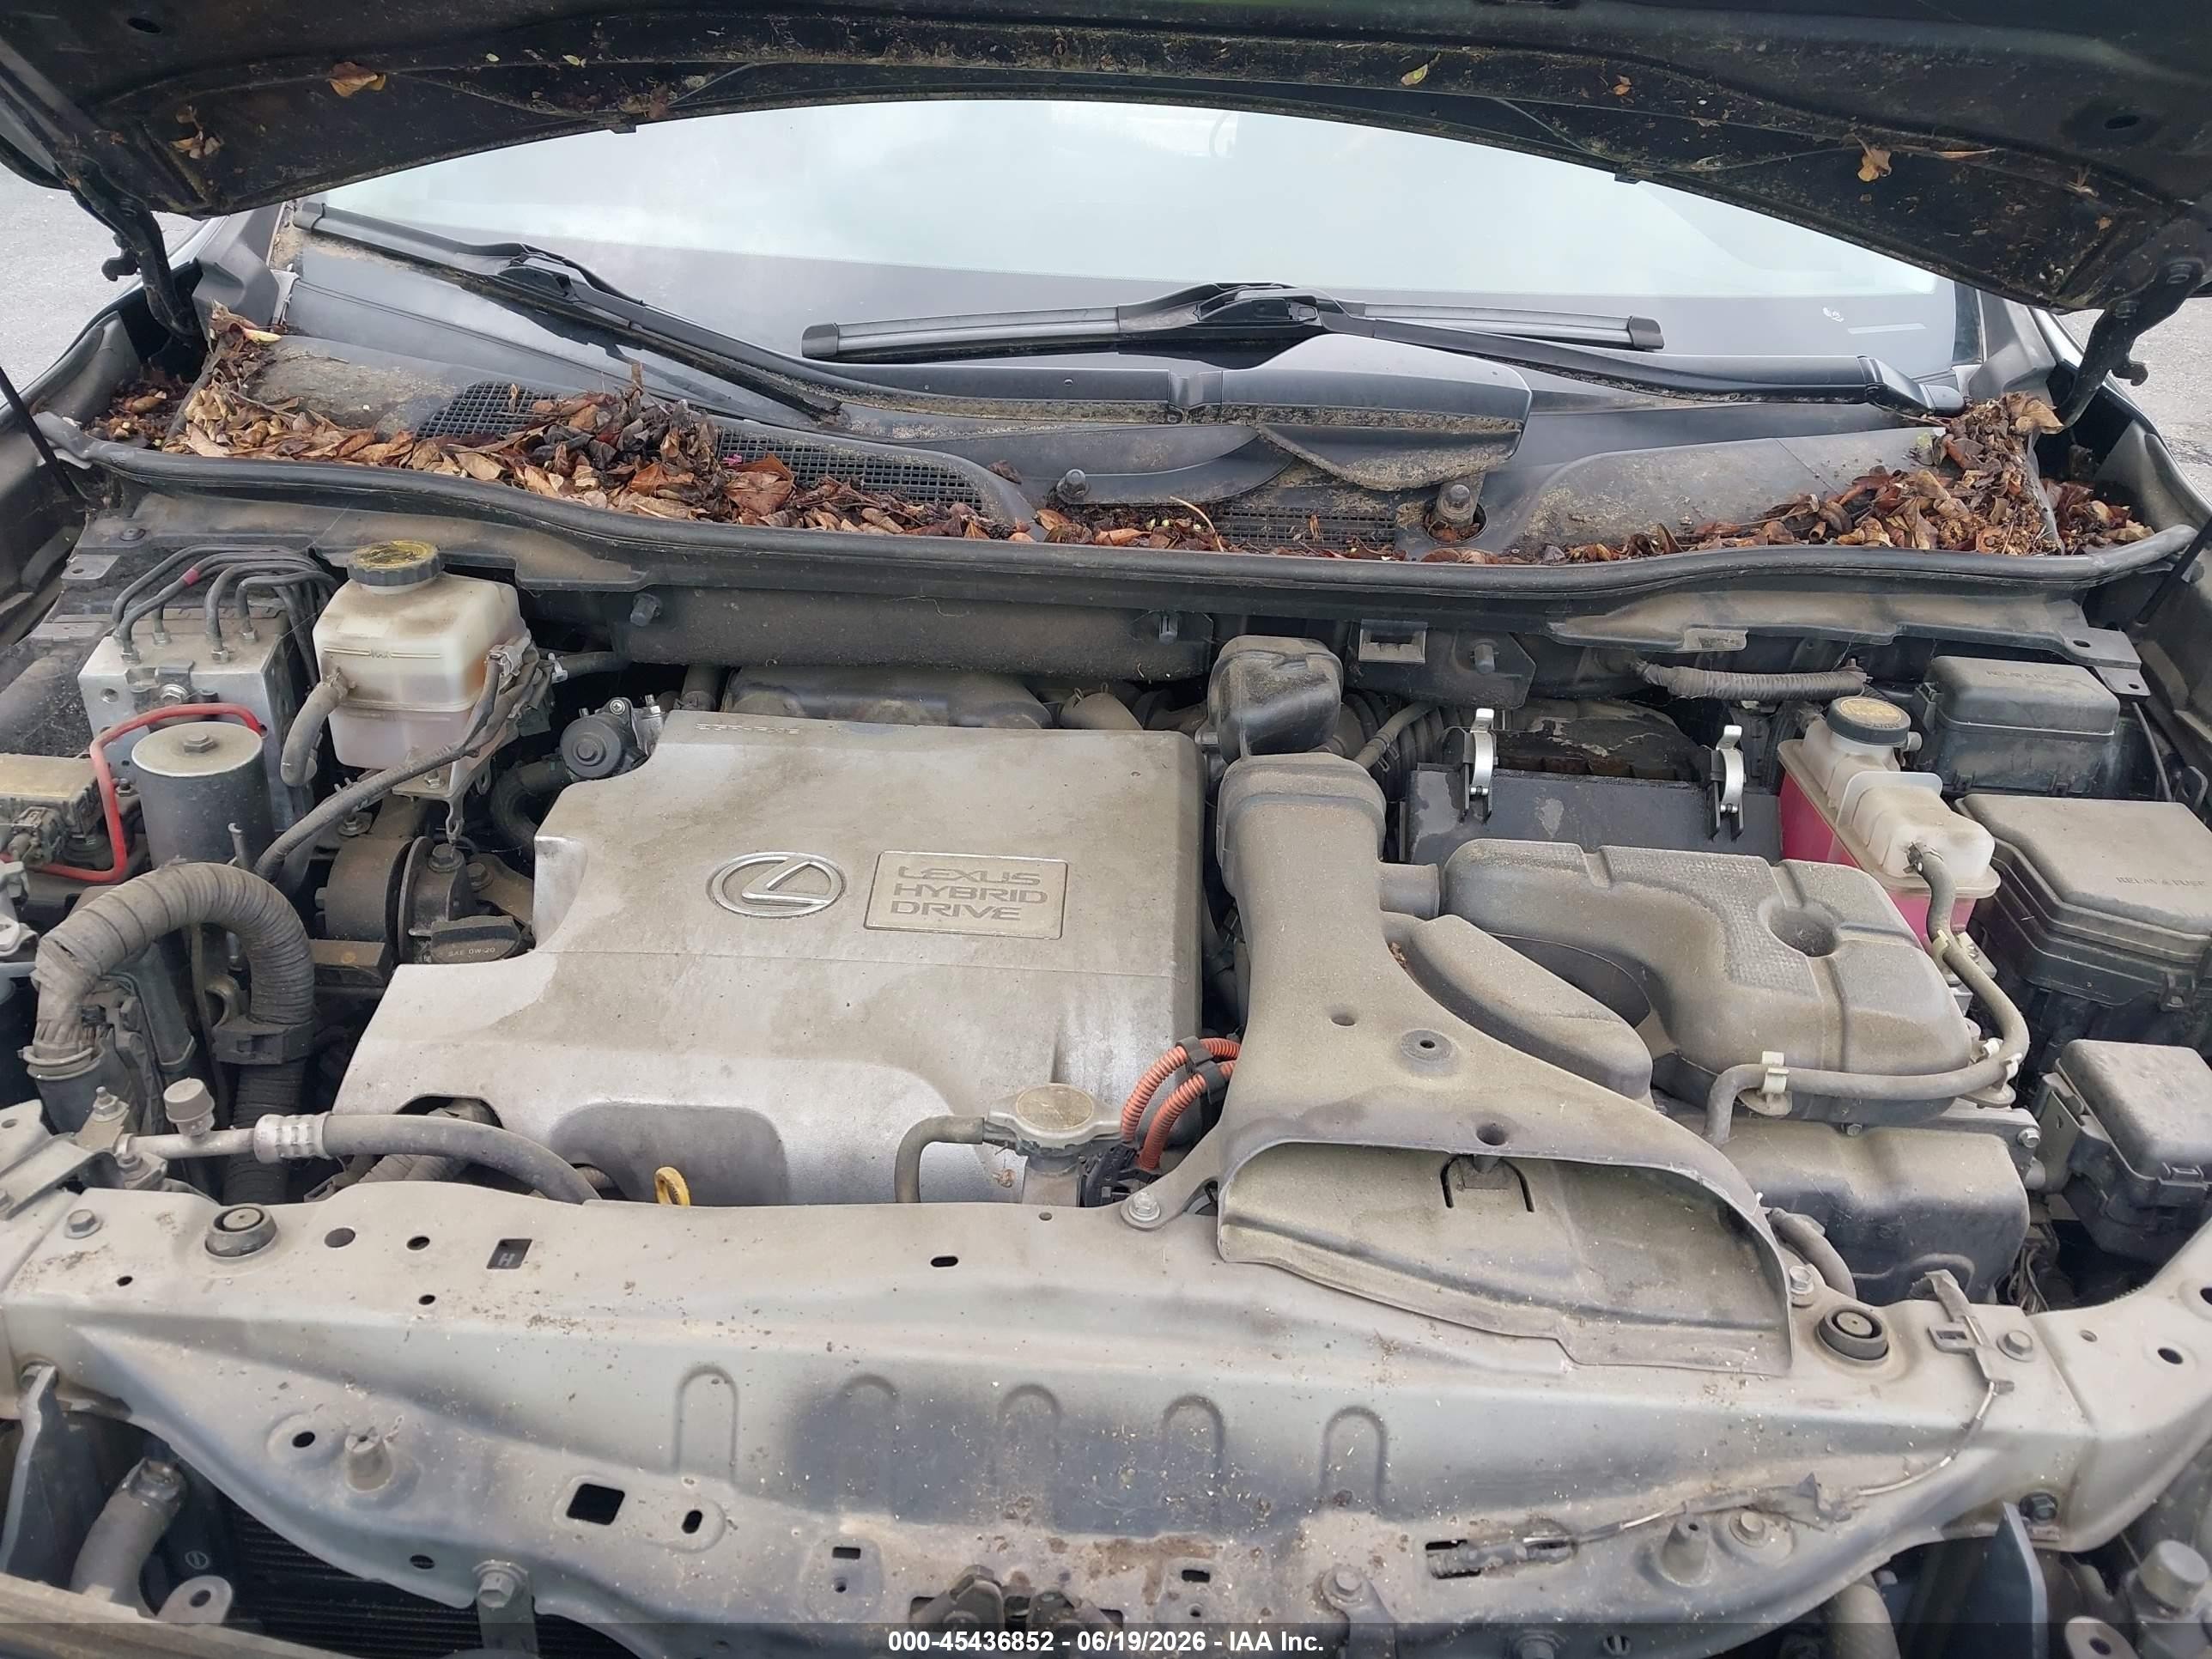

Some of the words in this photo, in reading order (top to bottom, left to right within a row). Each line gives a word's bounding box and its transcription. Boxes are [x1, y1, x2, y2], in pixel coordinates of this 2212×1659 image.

[898, 866, 1041, 885] LEXUS
[893, 884, 1048, 903] HYBRID
[890, 900, 1022, 921] DRIVE
